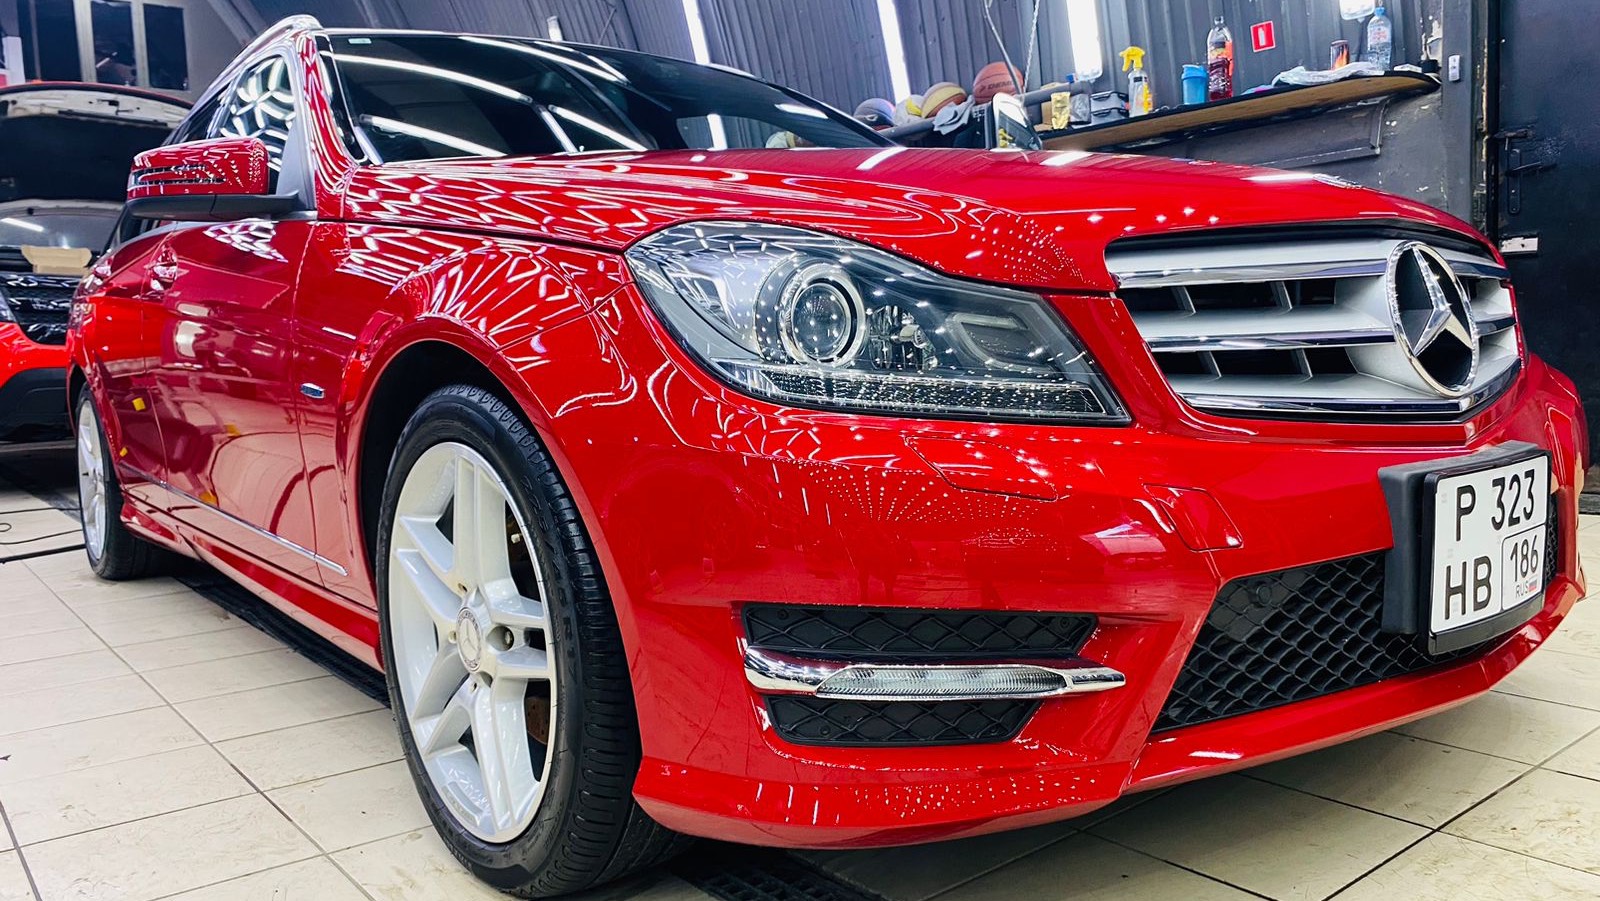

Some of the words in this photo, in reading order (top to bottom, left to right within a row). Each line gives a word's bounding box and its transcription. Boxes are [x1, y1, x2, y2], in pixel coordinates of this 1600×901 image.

[1456, 485, 1476, 541] P
[1491, 469, 1535, 531] 323
[1510, 535, 1538, 582] 186
[1445, 556, 1492, 620] HB
[1515, 581, 1529, 597] RUS
